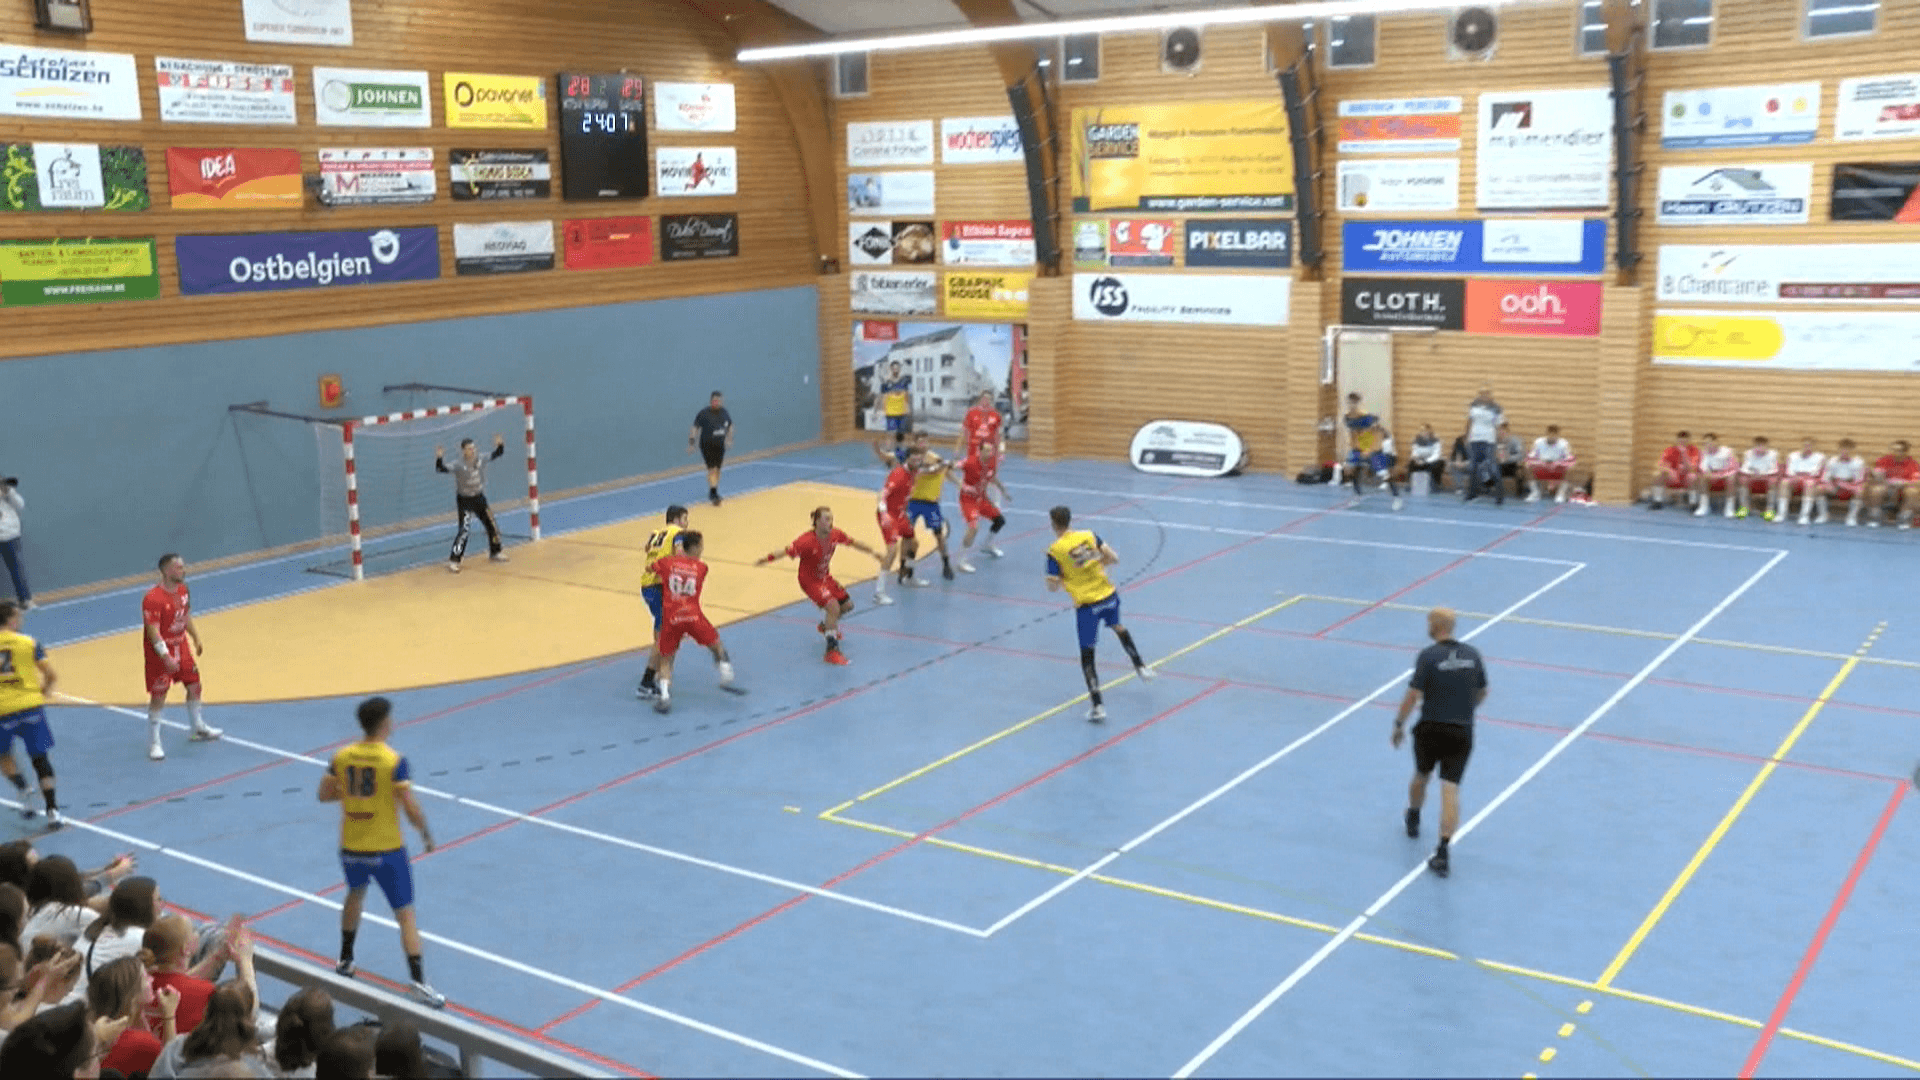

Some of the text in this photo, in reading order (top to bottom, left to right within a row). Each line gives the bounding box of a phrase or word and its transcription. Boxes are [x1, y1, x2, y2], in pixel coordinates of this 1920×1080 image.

[356, 88, 419, 105] JOHNEN
[946, 128, 1022, 154] wochenspieg
[199, 153, 237, 179] IDEA
[1189, 230, 1287, 251] PIXELBAR
[1363, 228, 1464, 251] JOHNEN
[229, 251, 372, 285] Ostbelgien
[1094, 284, 1128, 307] ISS
[669, 573, 697, 597] 64
[346, 765, 377, 798] 18
